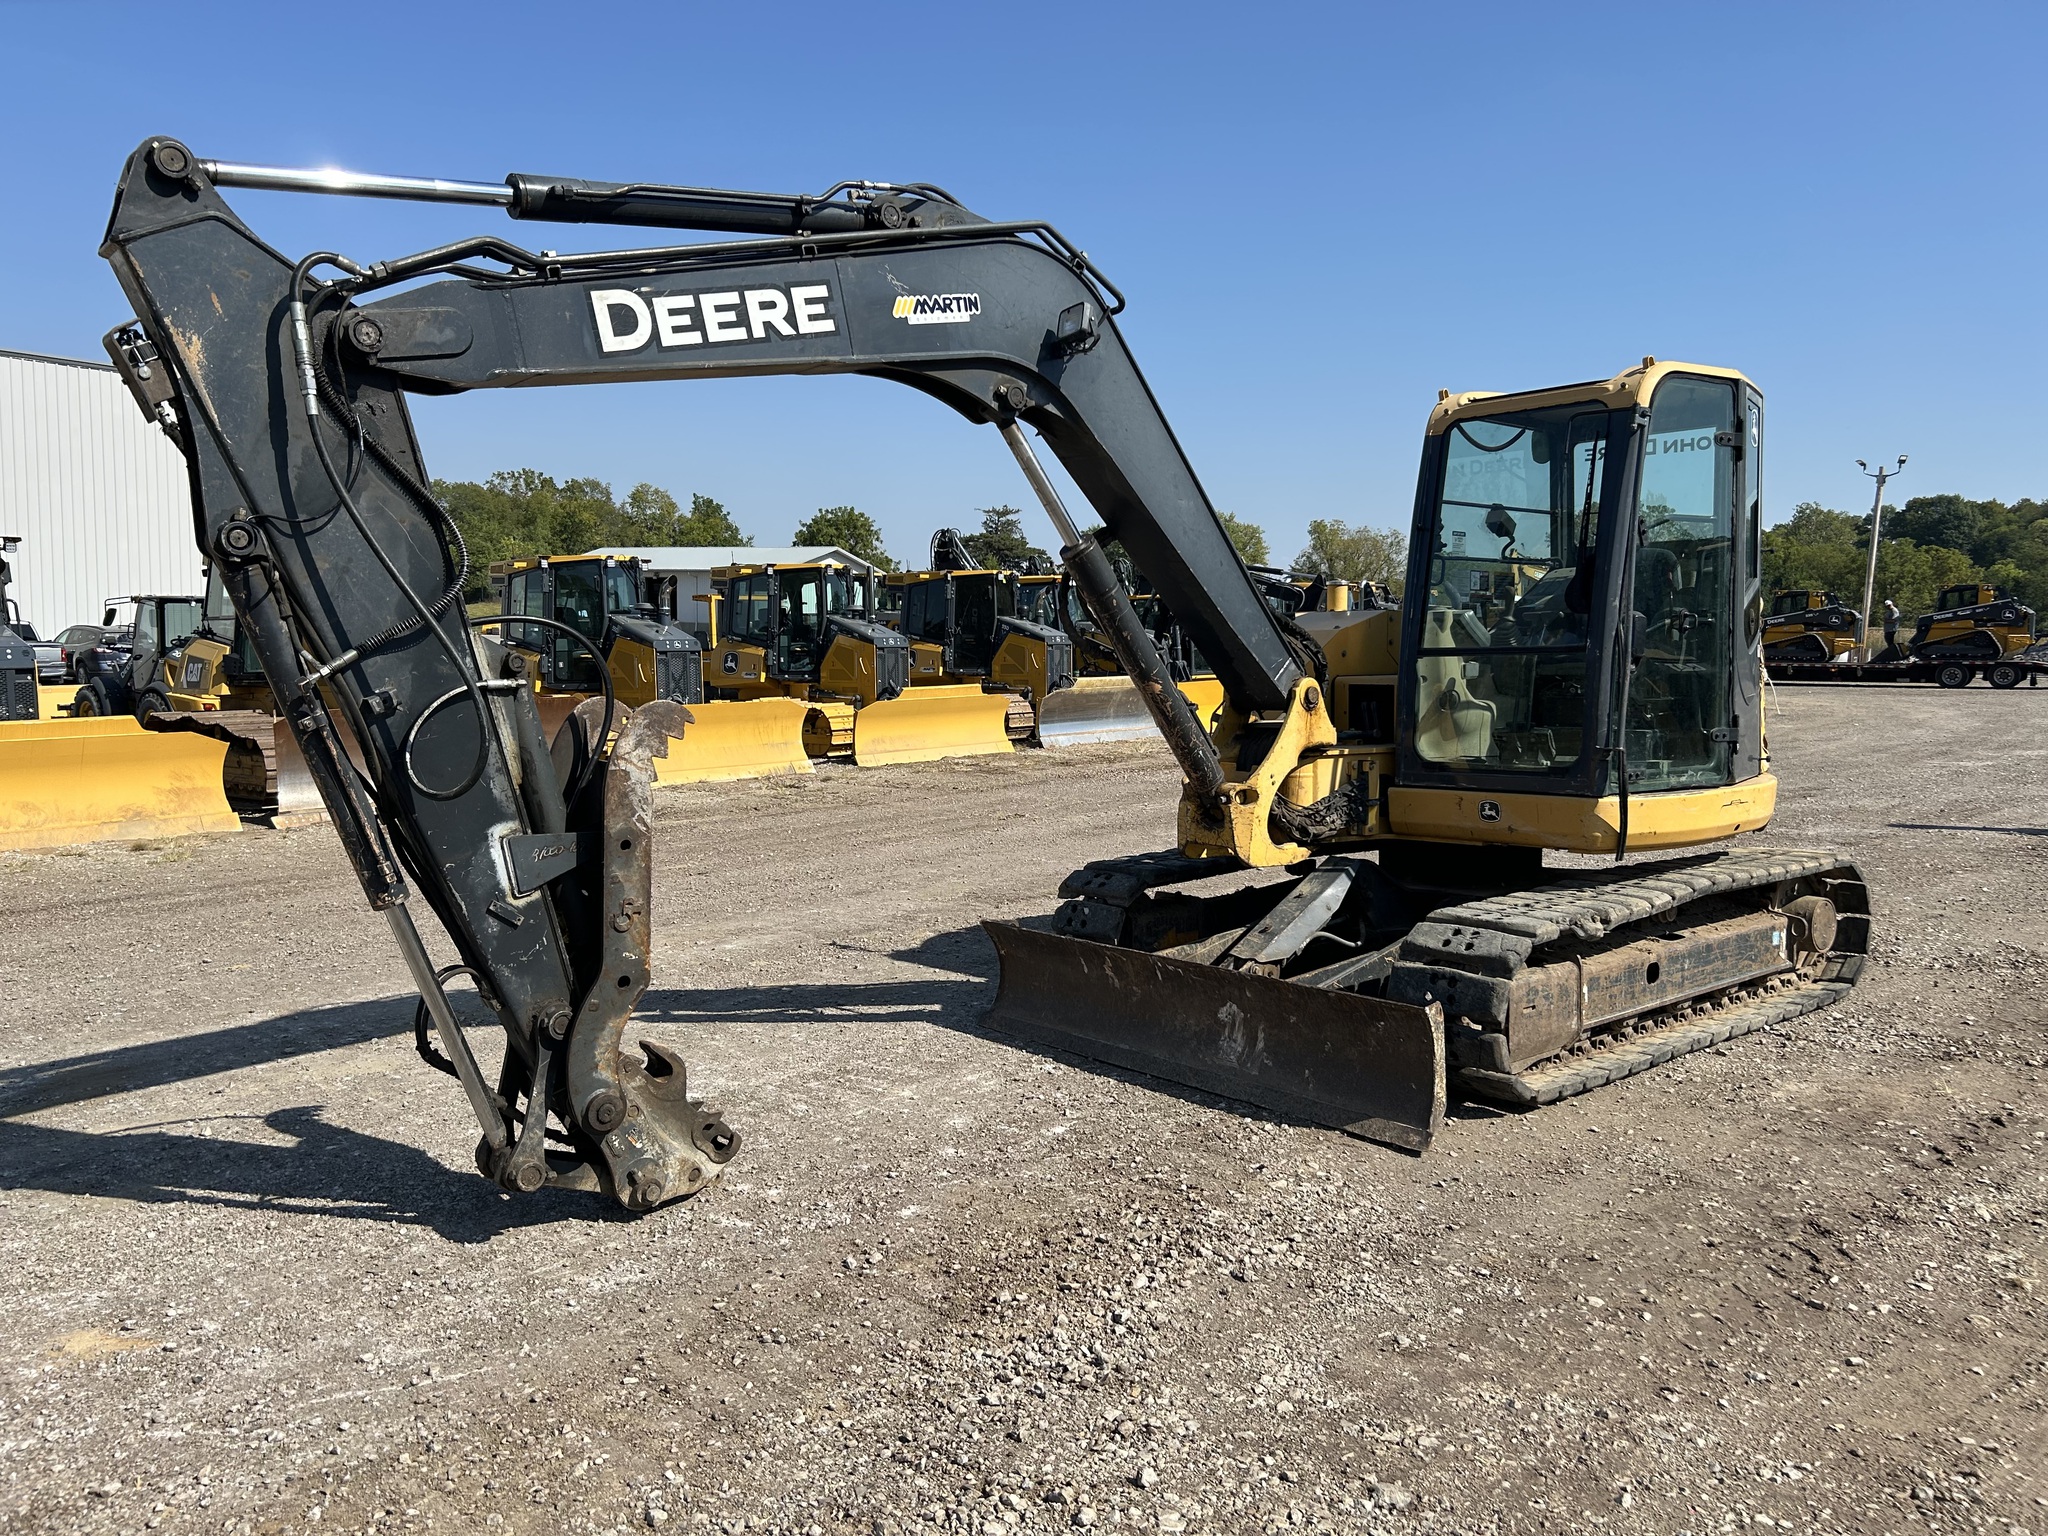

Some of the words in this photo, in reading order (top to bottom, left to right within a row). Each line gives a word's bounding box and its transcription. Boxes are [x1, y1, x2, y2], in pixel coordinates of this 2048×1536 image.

[913, 296, 979, 314] MARTIN
[590, 285, 835, 352] DEERE
[187, 662, 203, 682] CAT
